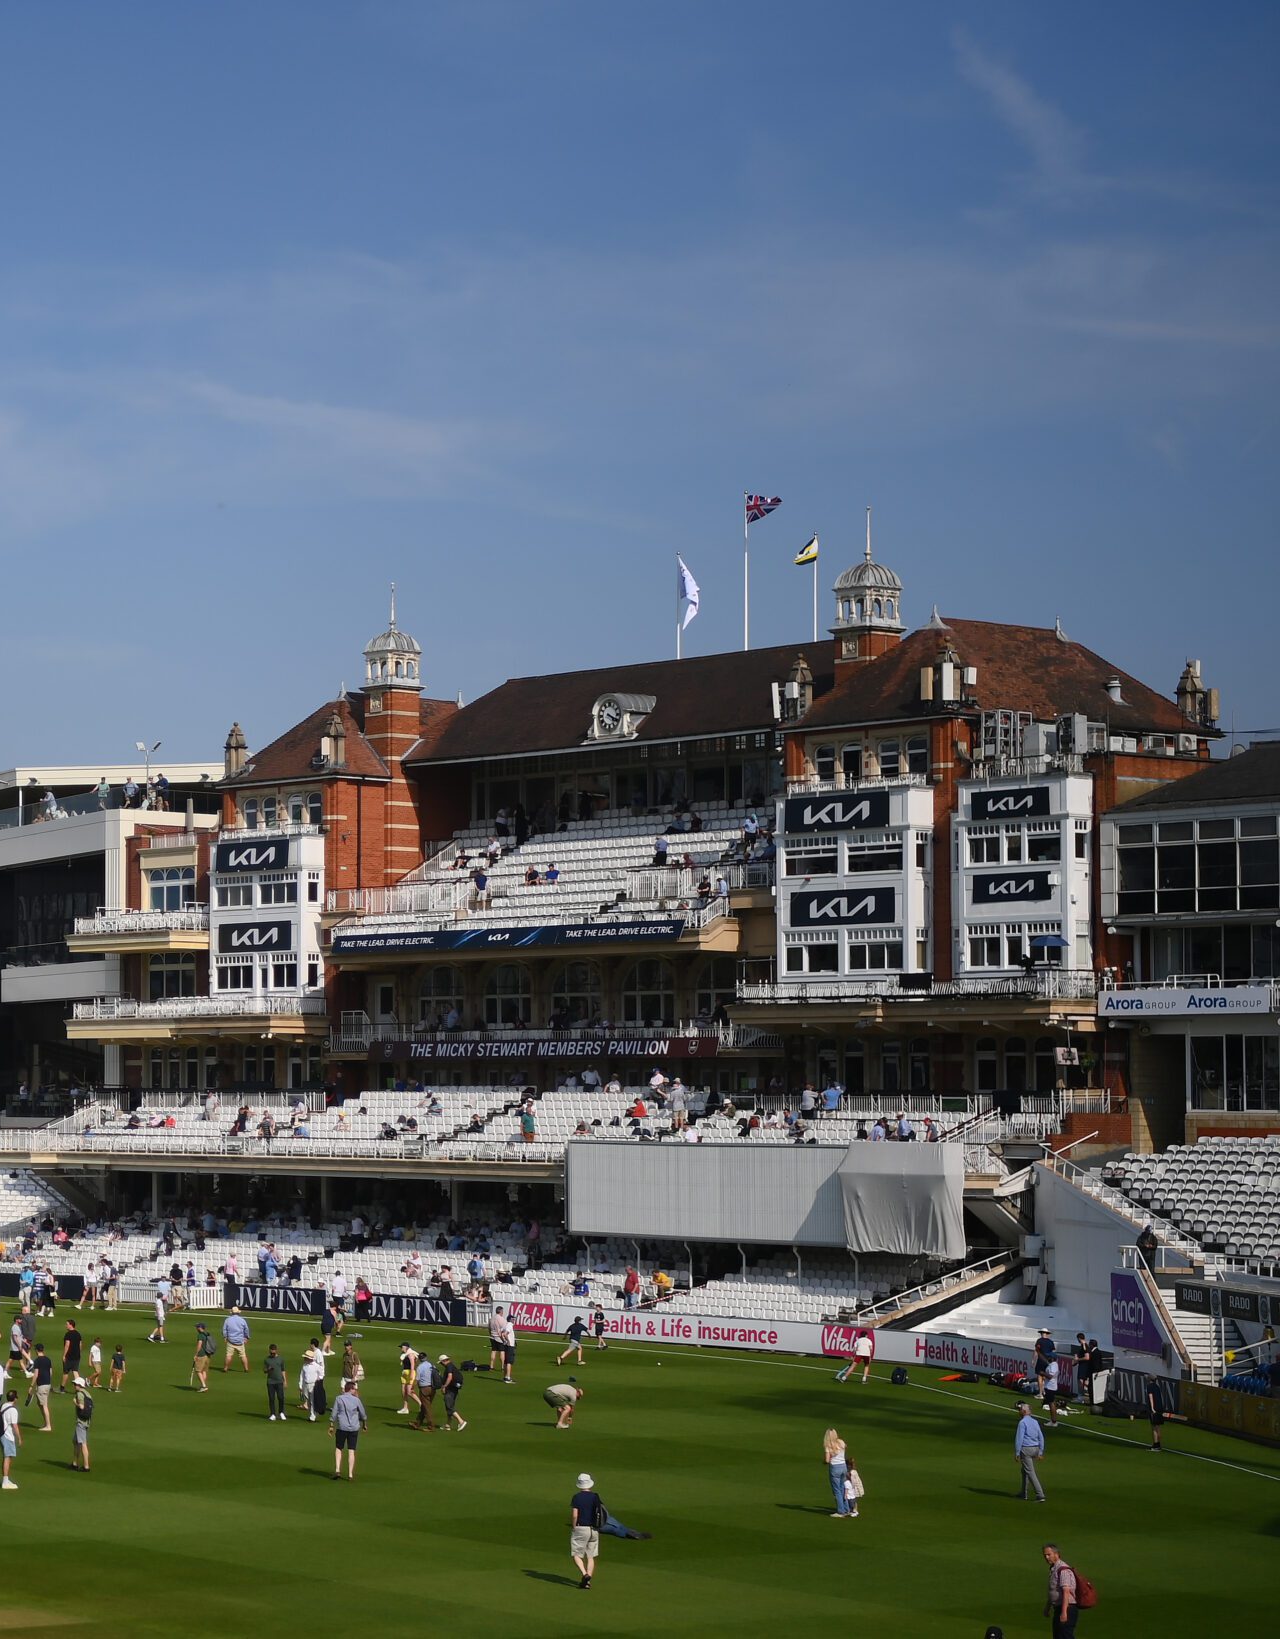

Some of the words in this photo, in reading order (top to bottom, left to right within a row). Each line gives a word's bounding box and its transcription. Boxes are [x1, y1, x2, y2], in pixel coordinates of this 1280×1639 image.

[803, 800, 870, 825] KIA
[987, 795, 1033, 812] KIA
[229, 847, 275, 866] KIA
[988, 879, 1035, 895] KIA
[809, 896, 875, 919] KIA
[231, 927, 278, 947] KIA
[488, 933, 510, 941] KIA
[565, 930, 582, 938] TAKE
[584, 929, 597, 937] THE
[597, 928, 617, 936] LEAD.
[618, 927, 639, 935] DRIVE
[640, 926, 674, 935] ELECTRIC.
[340, 940, 354, 948] TAKE
[368, 939, 385, 947] LEAD.
[386, 938, 404, 946] DRIVE
[405, 936, 434, 945] ELECTRIC.
[1105, 997, 1143, 1010] Arora
[1145, 1002, 1176, 1010] GROUP
[1186, 995, 1227, 1008] Arora
[1228, 1000, 1262, 1008] GROUP
[410, 1043, 433, 1057] THE
[435, 1043, 474, 1057] MICKY
[476, 1042, 534, 1056] STEWART
[537, 1041, 605, 1056] MEMBERS'
[608, 1040, 670, 1055] PAVILION
[236, 1286, 260, 1308] JM
[266, 1289, 312, 1313] FINN
[1182, 1288, 1203, 1303] RADO
[1229, 1295, 1250, 1311] RADO
[368, 1295, 395, 1319] JM
[401, 1298, 452, 1323] FINN
[511, 1302, 552, 1332] Vitality
[1112, 1290, 1144, 1326] cinch
[645, 1320, 656, 1336] &
[661, 1318, 692, 1339] Life
[698, 1319, 778, 1344] insurance
[824, 1325, 860, 1353] Vital
[916, 1338, 958, 1364] Health
[961, 1347, 969, 1364] &
[972, 1345, 988, 1369] Life
[990, 1350, 1028, 1375] insurance
